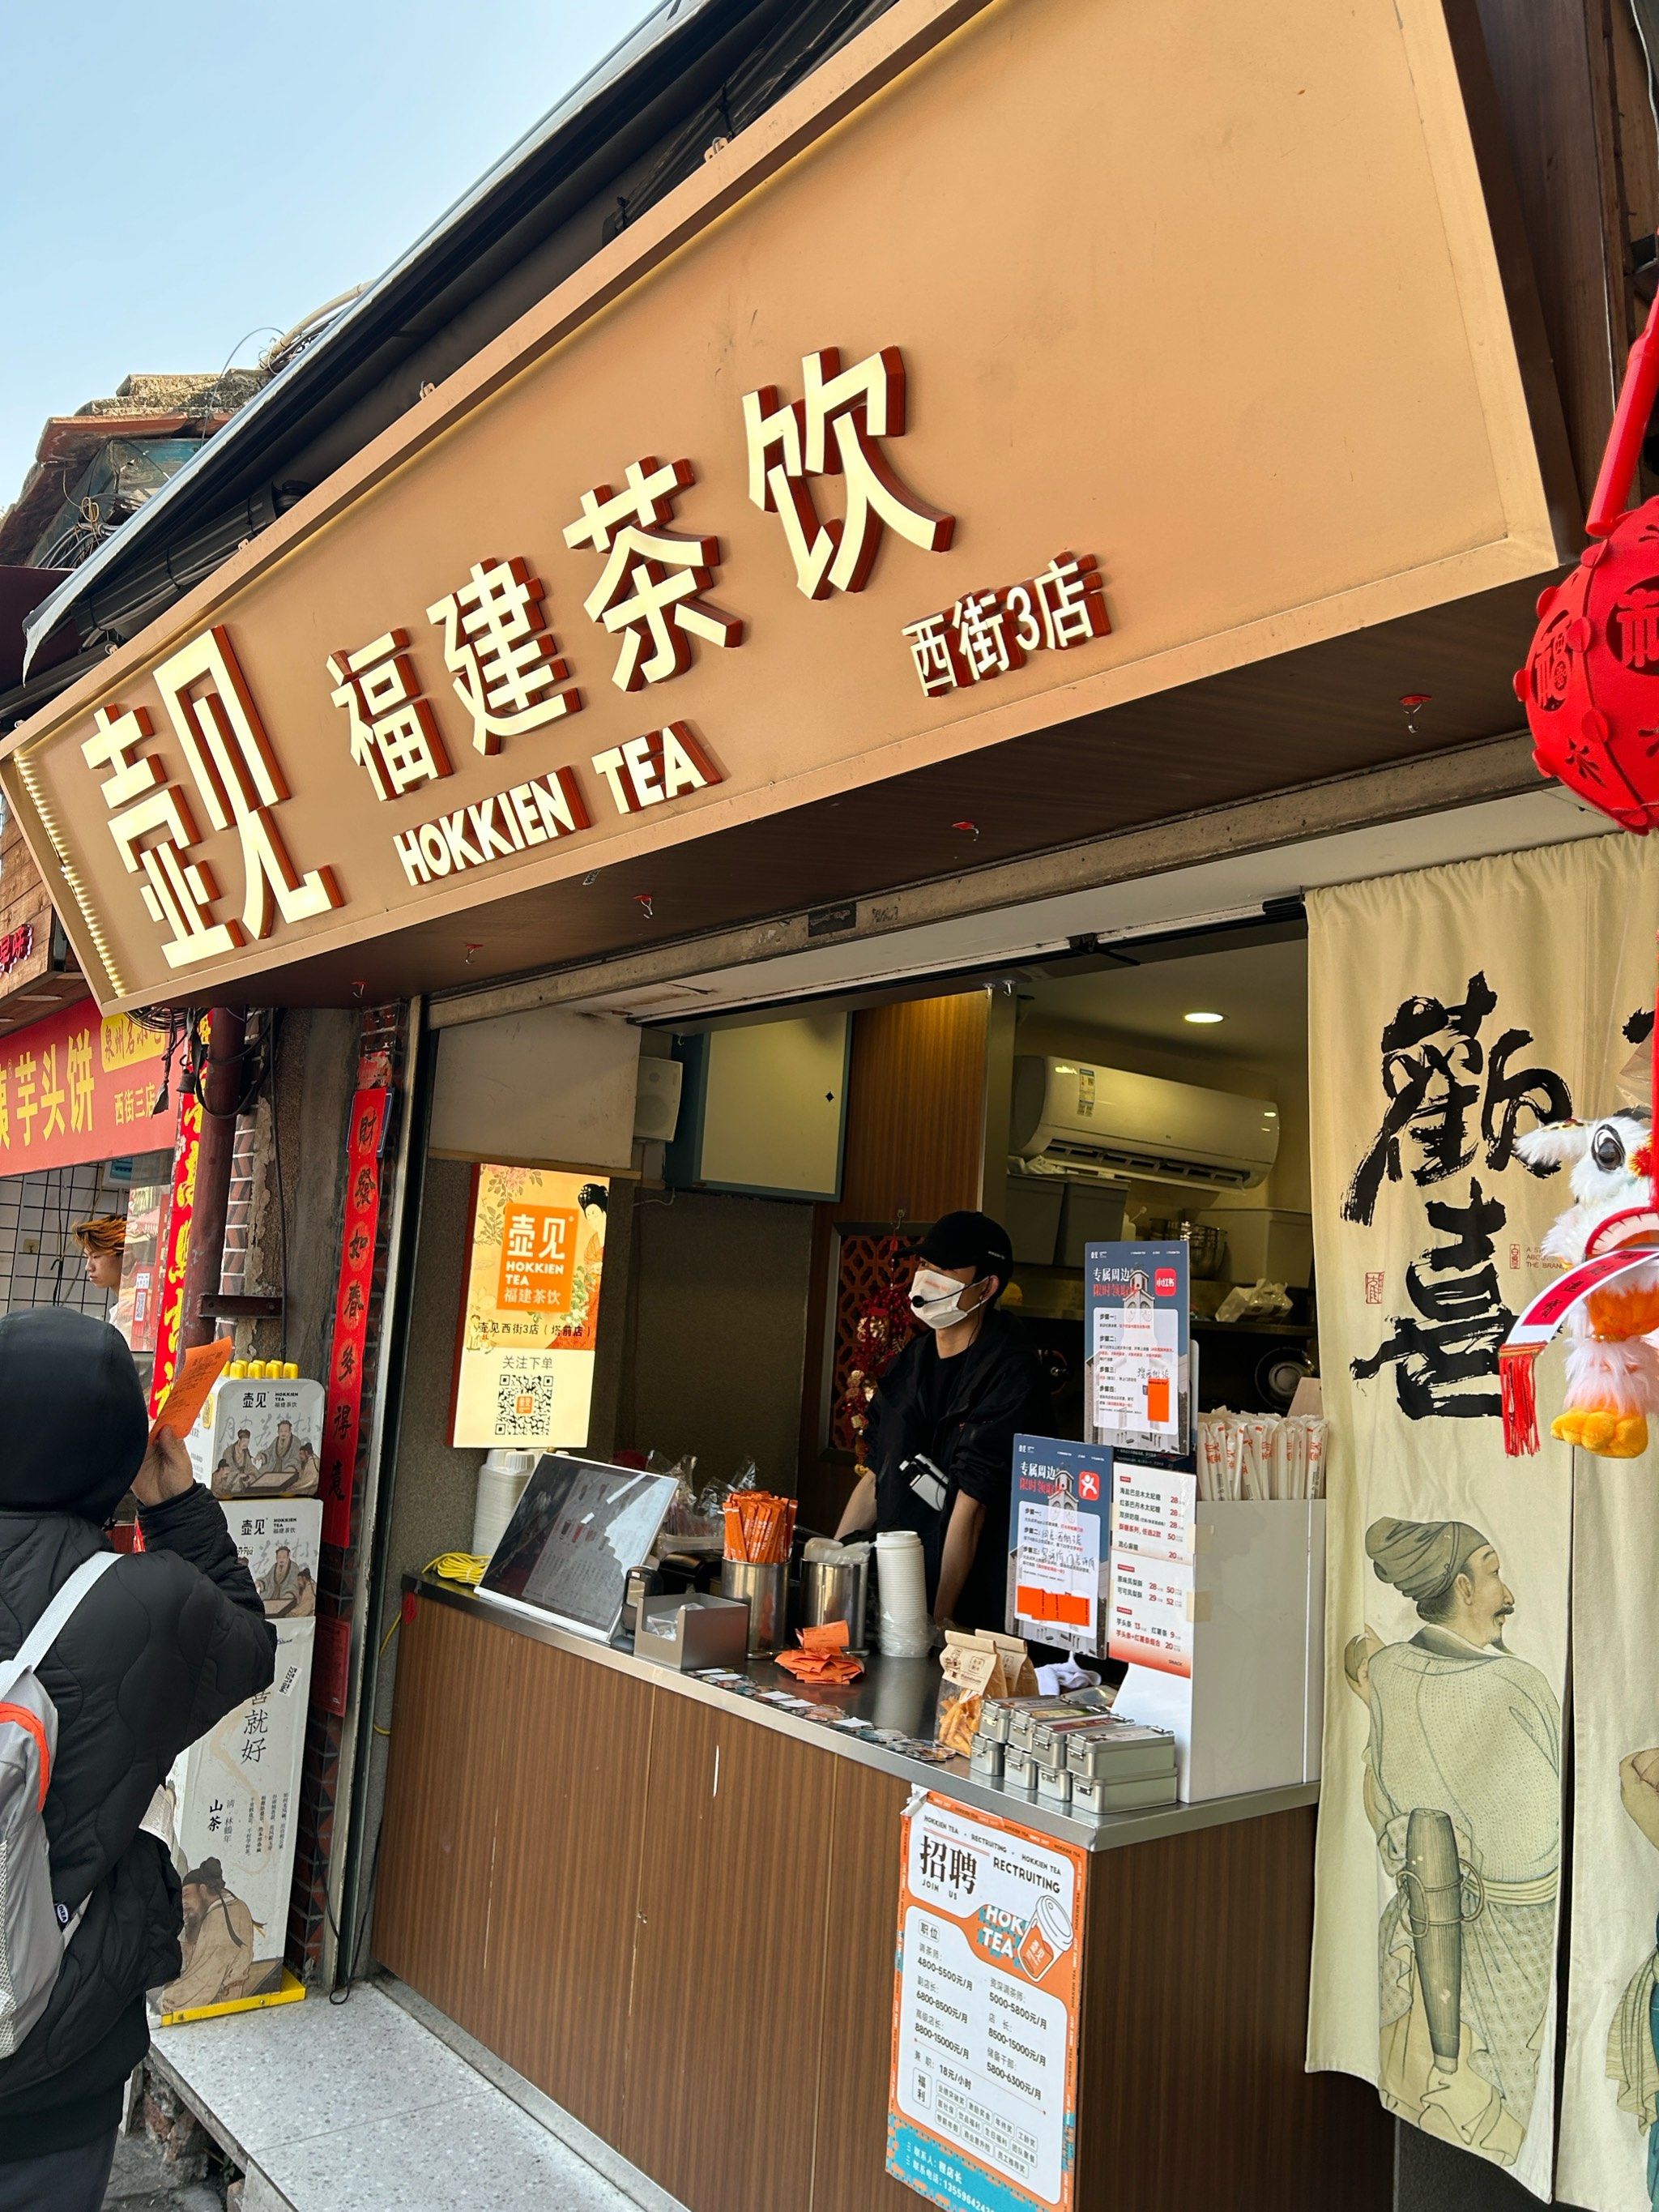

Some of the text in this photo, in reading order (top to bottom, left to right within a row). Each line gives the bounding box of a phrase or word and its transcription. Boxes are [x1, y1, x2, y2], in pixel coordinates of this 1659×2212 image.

[327, 347, 949, 801] 福建茶饮
[902, 551, 1107, 698] 西街3店
[81, 626, 340, 968] 壶见
[392, 721, 718, 886] HOKKIEN TEA
[507, 1214, 565, 1259] 壶见
[505, 1275, 529, 1286] TEA
[506, 1261, 564, 1275] HOKKIEN
[505, 1287, 561, 1305] 福建茶饮
[502, 1356, 552, 1370] 关注下单
[243, 1392, 267, 1407] 壶见
[241, 1519, 265, 1535] 壶见
[207, 1799, 223, 1831] 山茶
[924, 1816, 1061, 1876] HOKKIEN TEA RECTRUITING HOKKIEN TEA
[919, 1835, 977, 1894] 招聘
[993, 1857, 1060, 1894] RECTRUITING
[922, 1879, 957, 1900] JOIN US
[920, 1922, 939, 1940] 职位
[986, 1905, 1030, 1936] HOK
[983, 1928, 1013, 1958] TEA
[917, 1957, 973, 1991] 4800-5500元/月
[916, 1990, 1047, 2031] 6800-8500元/月 5000-5800元/月
[915, 2023, 1046, 2067] 8800-15000元/月 8500-15000元/月
[917, 2075, 926, 2103] 福利
[940, 2065, 971, 2090] 18元/小时
[987, 2062, 1042, 2100] 5800-6300元/月
[985, 2128, 1008, 2147] 生日福利
[995, 2117, 1013, 2133] 年终奖
